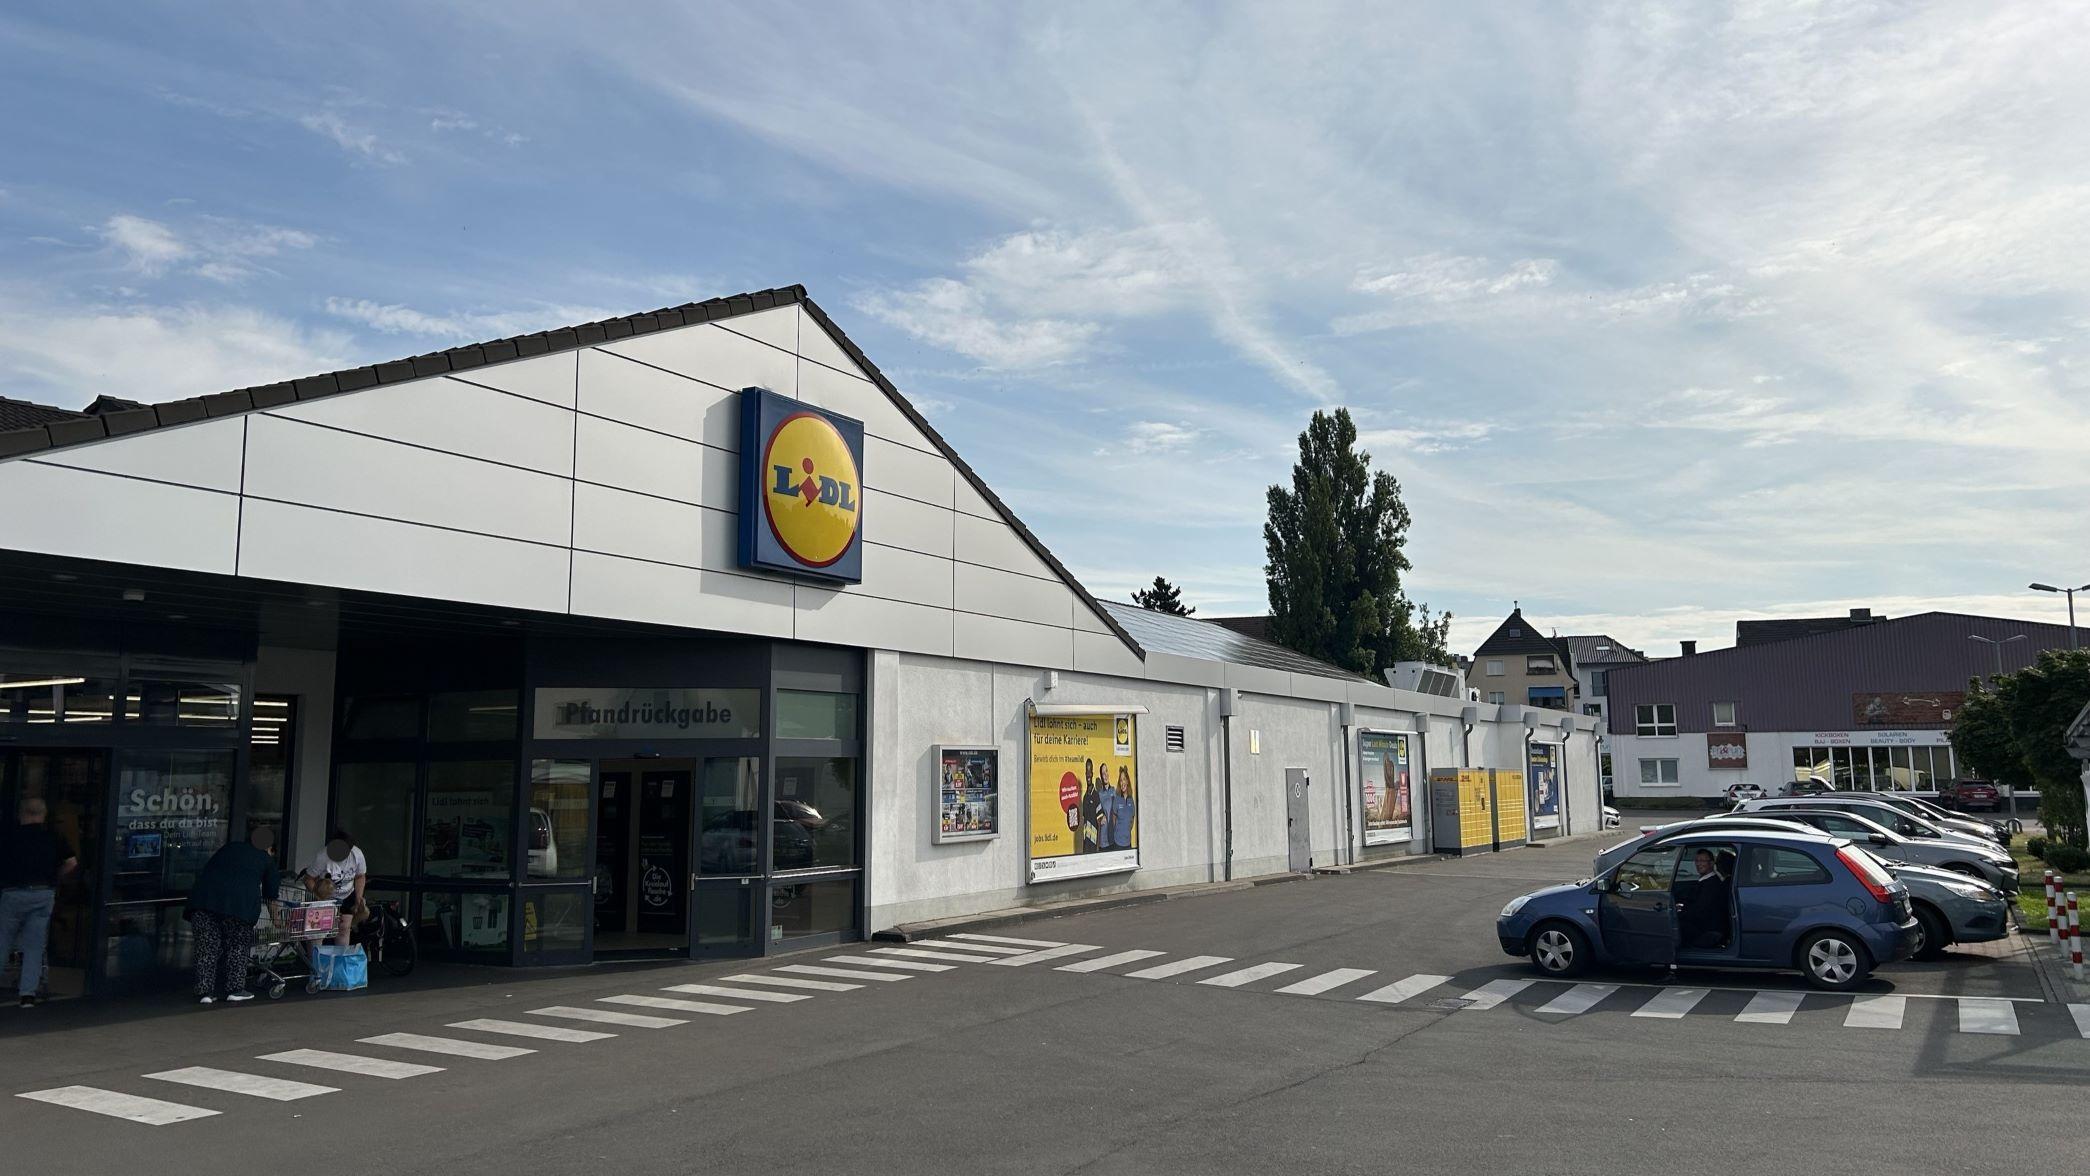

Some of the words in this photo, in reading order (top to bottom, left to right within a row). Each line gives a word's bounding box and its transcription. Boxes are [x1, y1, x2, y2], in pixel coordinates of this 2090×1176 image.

[566, 701, 732, 729] Pfandrückgabe
[1065, 719, 1076, 730] sich
[1083, 721, 1098, 731] auch
[1034, 733, 1043, 744] für
[1044, 734, 1062, 745] deine
[1063, 734, 1089, 746] Karriere!
[130, 787, 219, 814] Schön,
[129, 820, 156, 830] dass
[160, 819, 175, 829] du
[178, 818, 193, 828] da
[196, 817, 218, 828] bist
